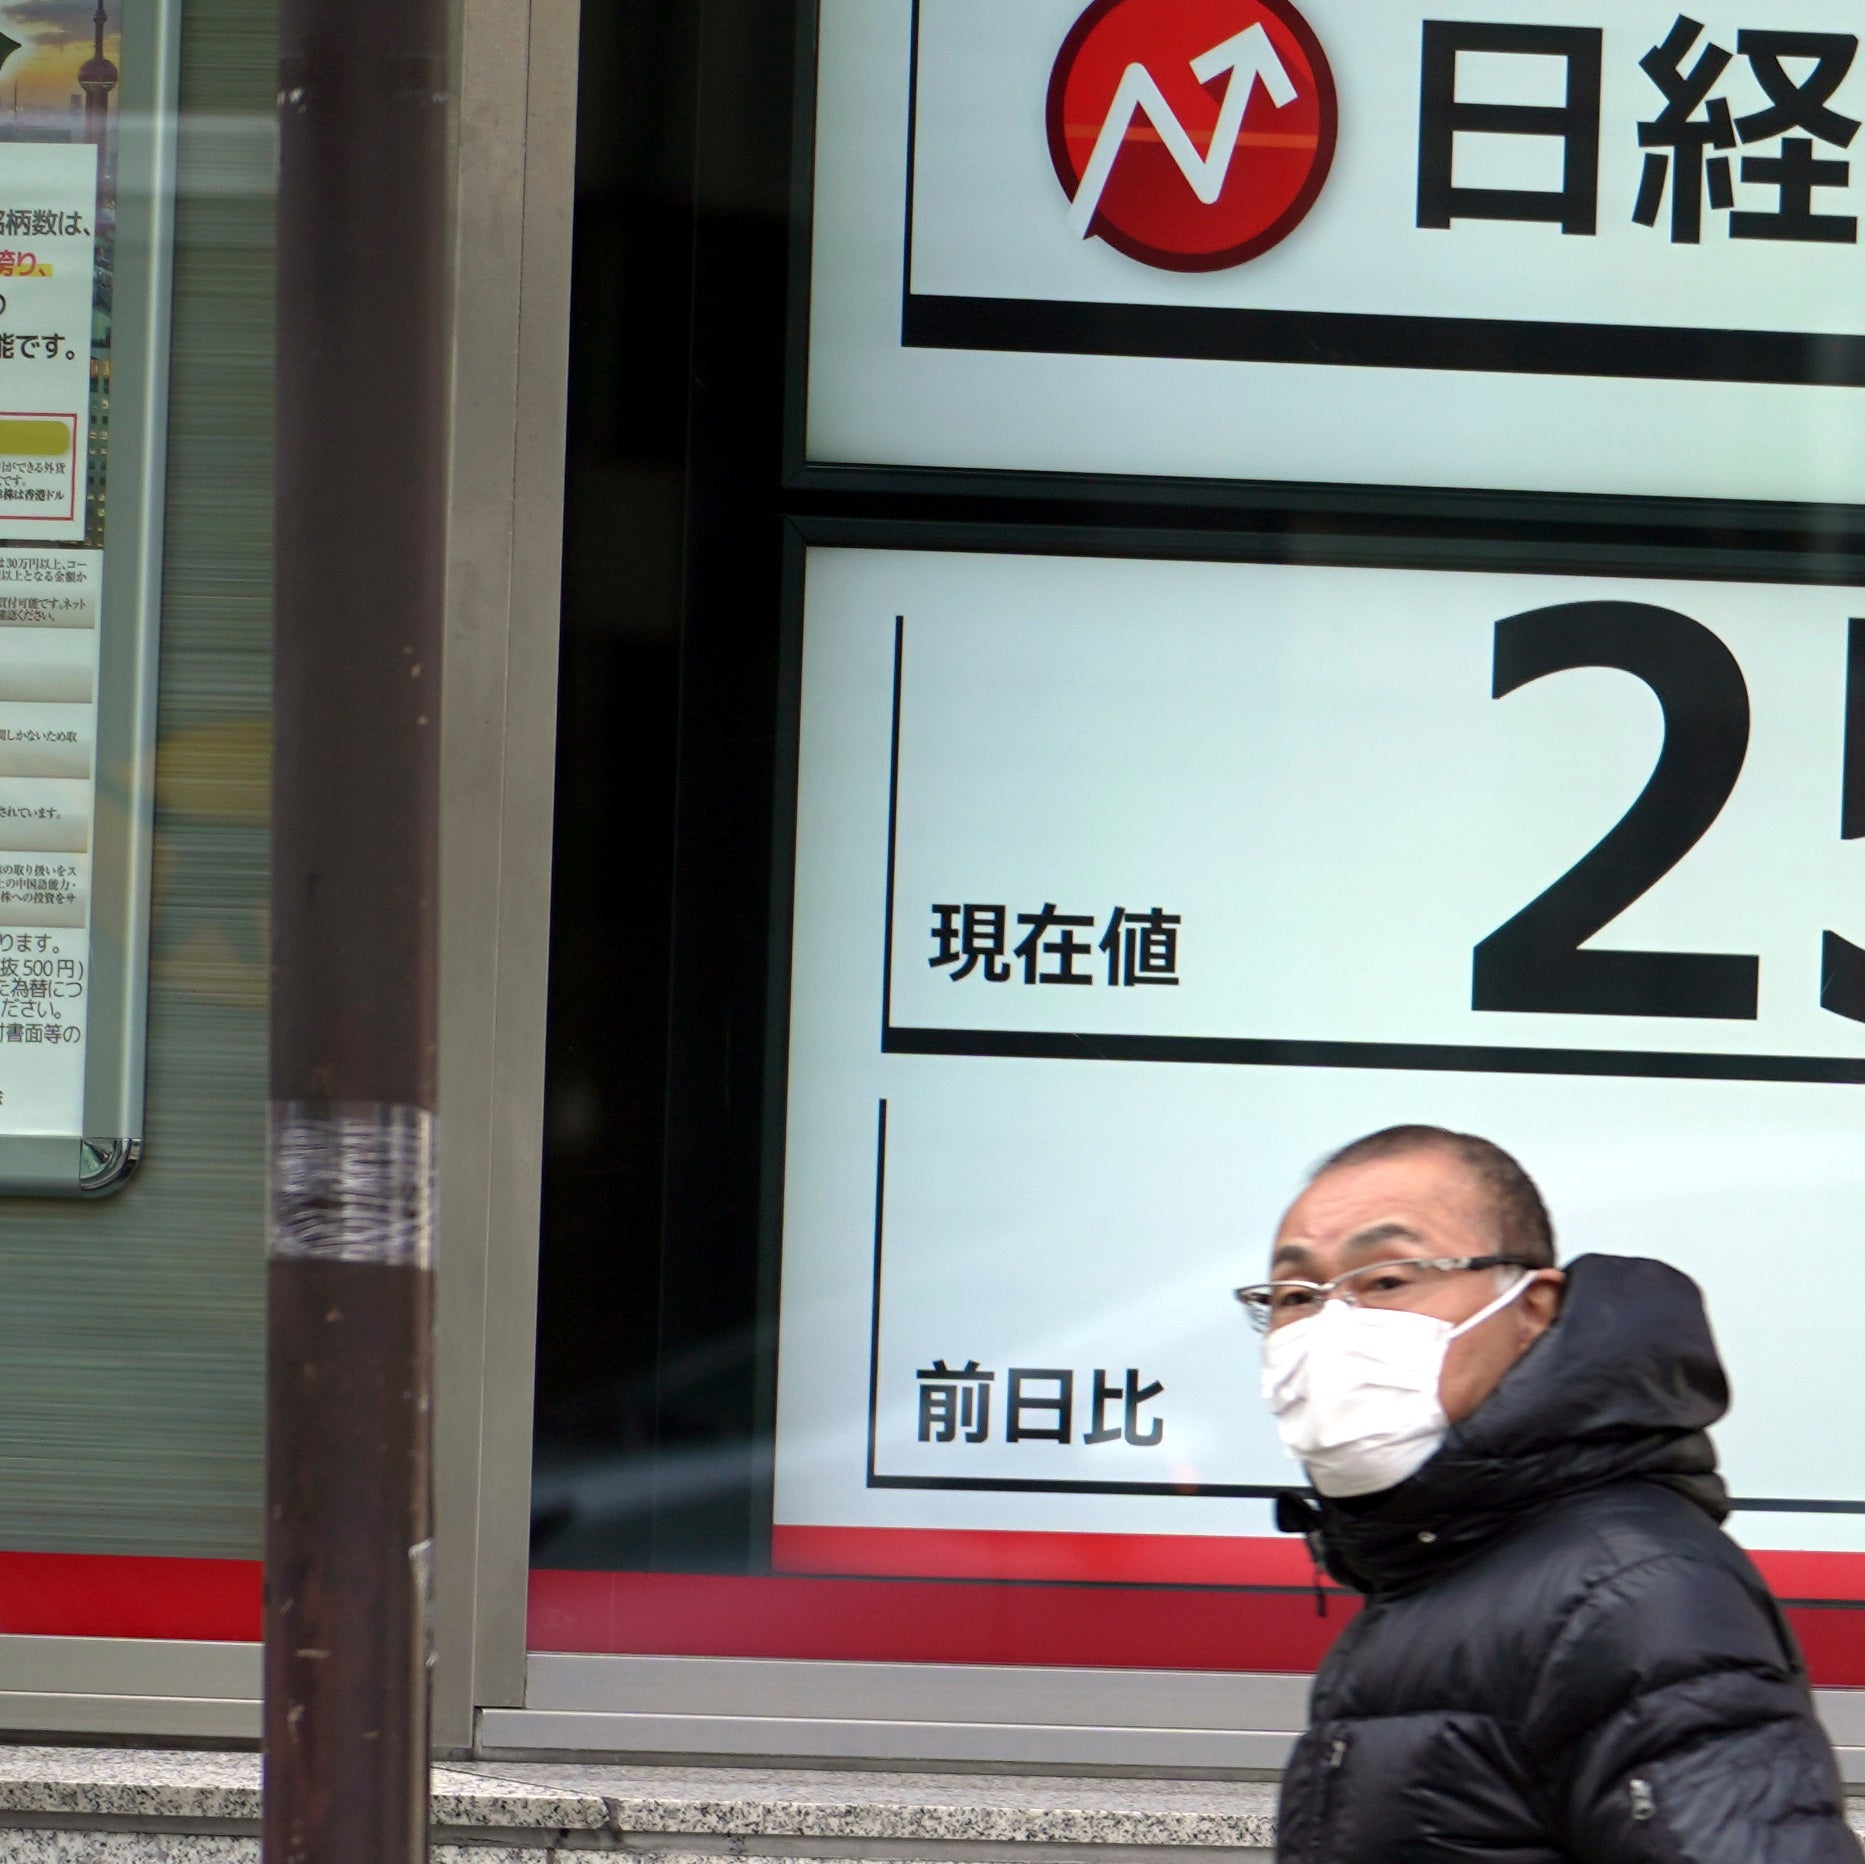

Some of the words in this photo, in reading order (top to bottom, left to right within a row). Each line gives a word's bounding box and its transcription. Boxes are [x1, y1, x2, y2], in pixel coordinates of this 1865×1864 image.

[928, 901, 1183, 988] 現在値
[915, 1359, 1165, 1448] 前日比
